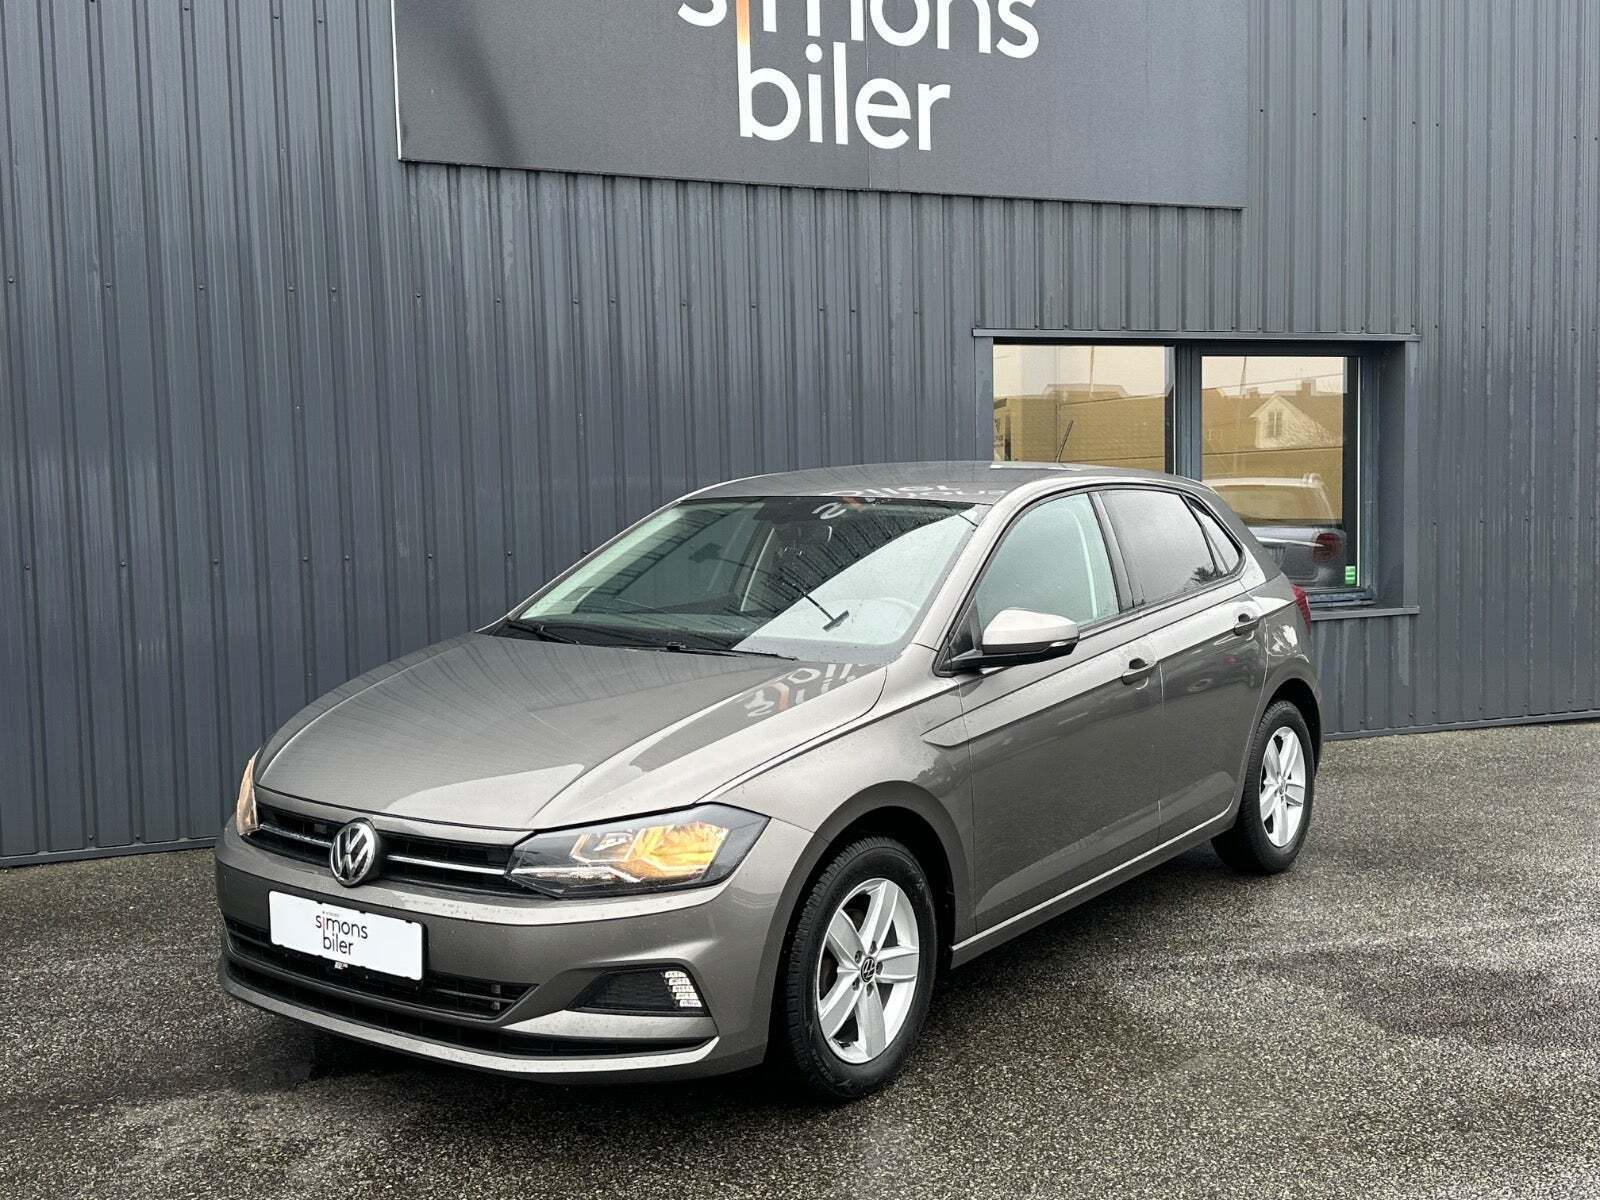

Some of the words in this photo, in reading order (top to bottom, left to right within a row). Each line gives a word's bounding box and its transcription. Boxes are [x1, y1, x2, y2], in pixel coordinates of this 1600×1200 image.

[737, 42, 951, 151] biler
[315, 914, 368, 939] simons
[323, 930, 354, 956] biler
